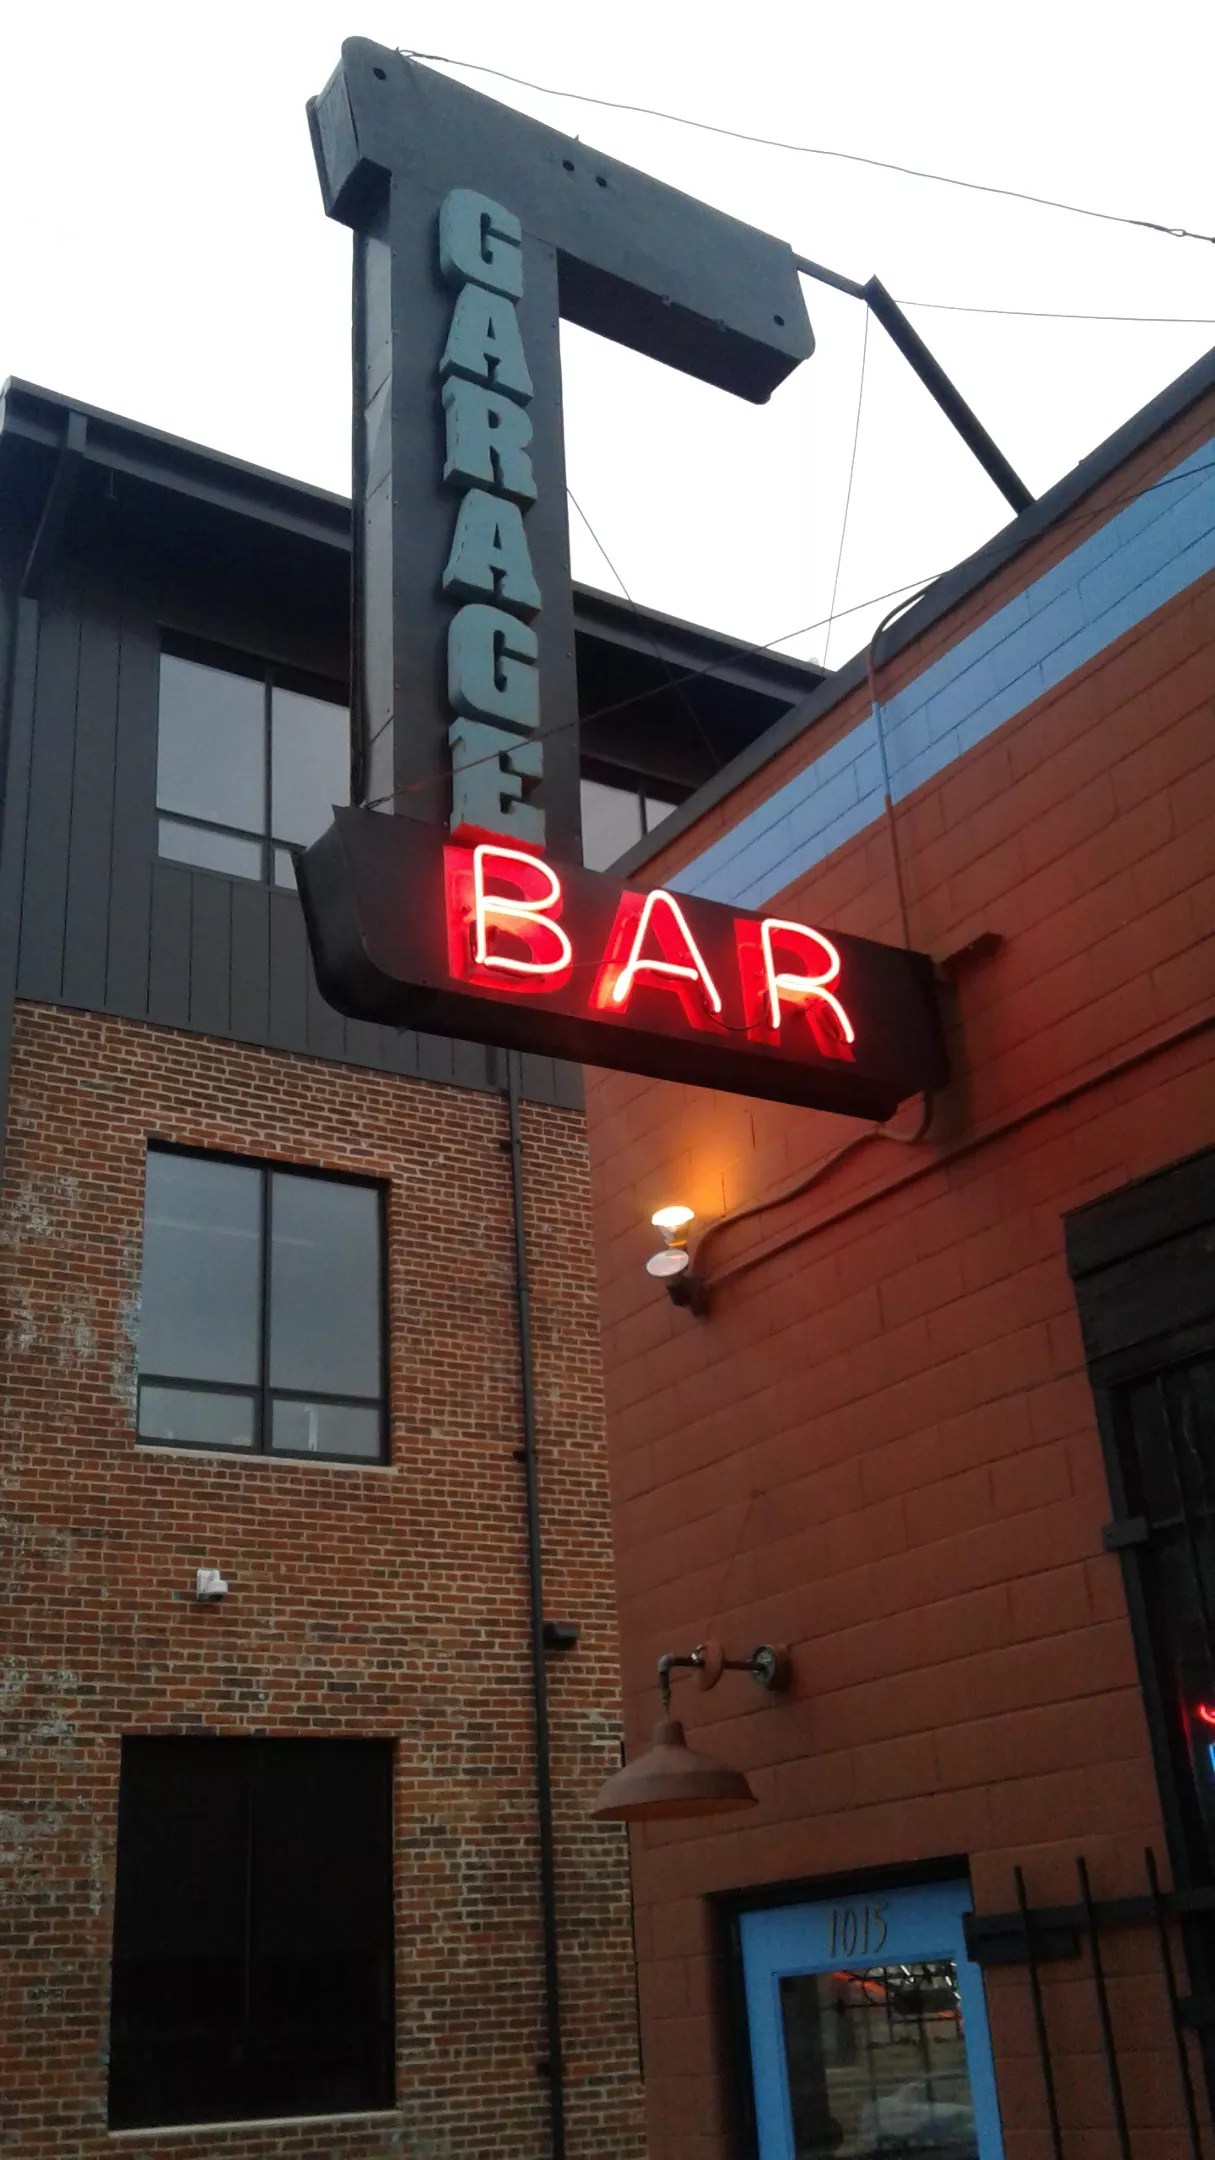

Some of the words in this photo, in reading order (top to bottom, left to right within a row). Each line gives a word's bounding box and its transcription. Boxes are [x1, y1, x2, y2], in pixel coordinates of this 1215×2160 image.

[438, 188, 547, 850] GARAGE
[443, 842, 858, 1062] BAR
[828, 1901, 889, 1959] 1015
